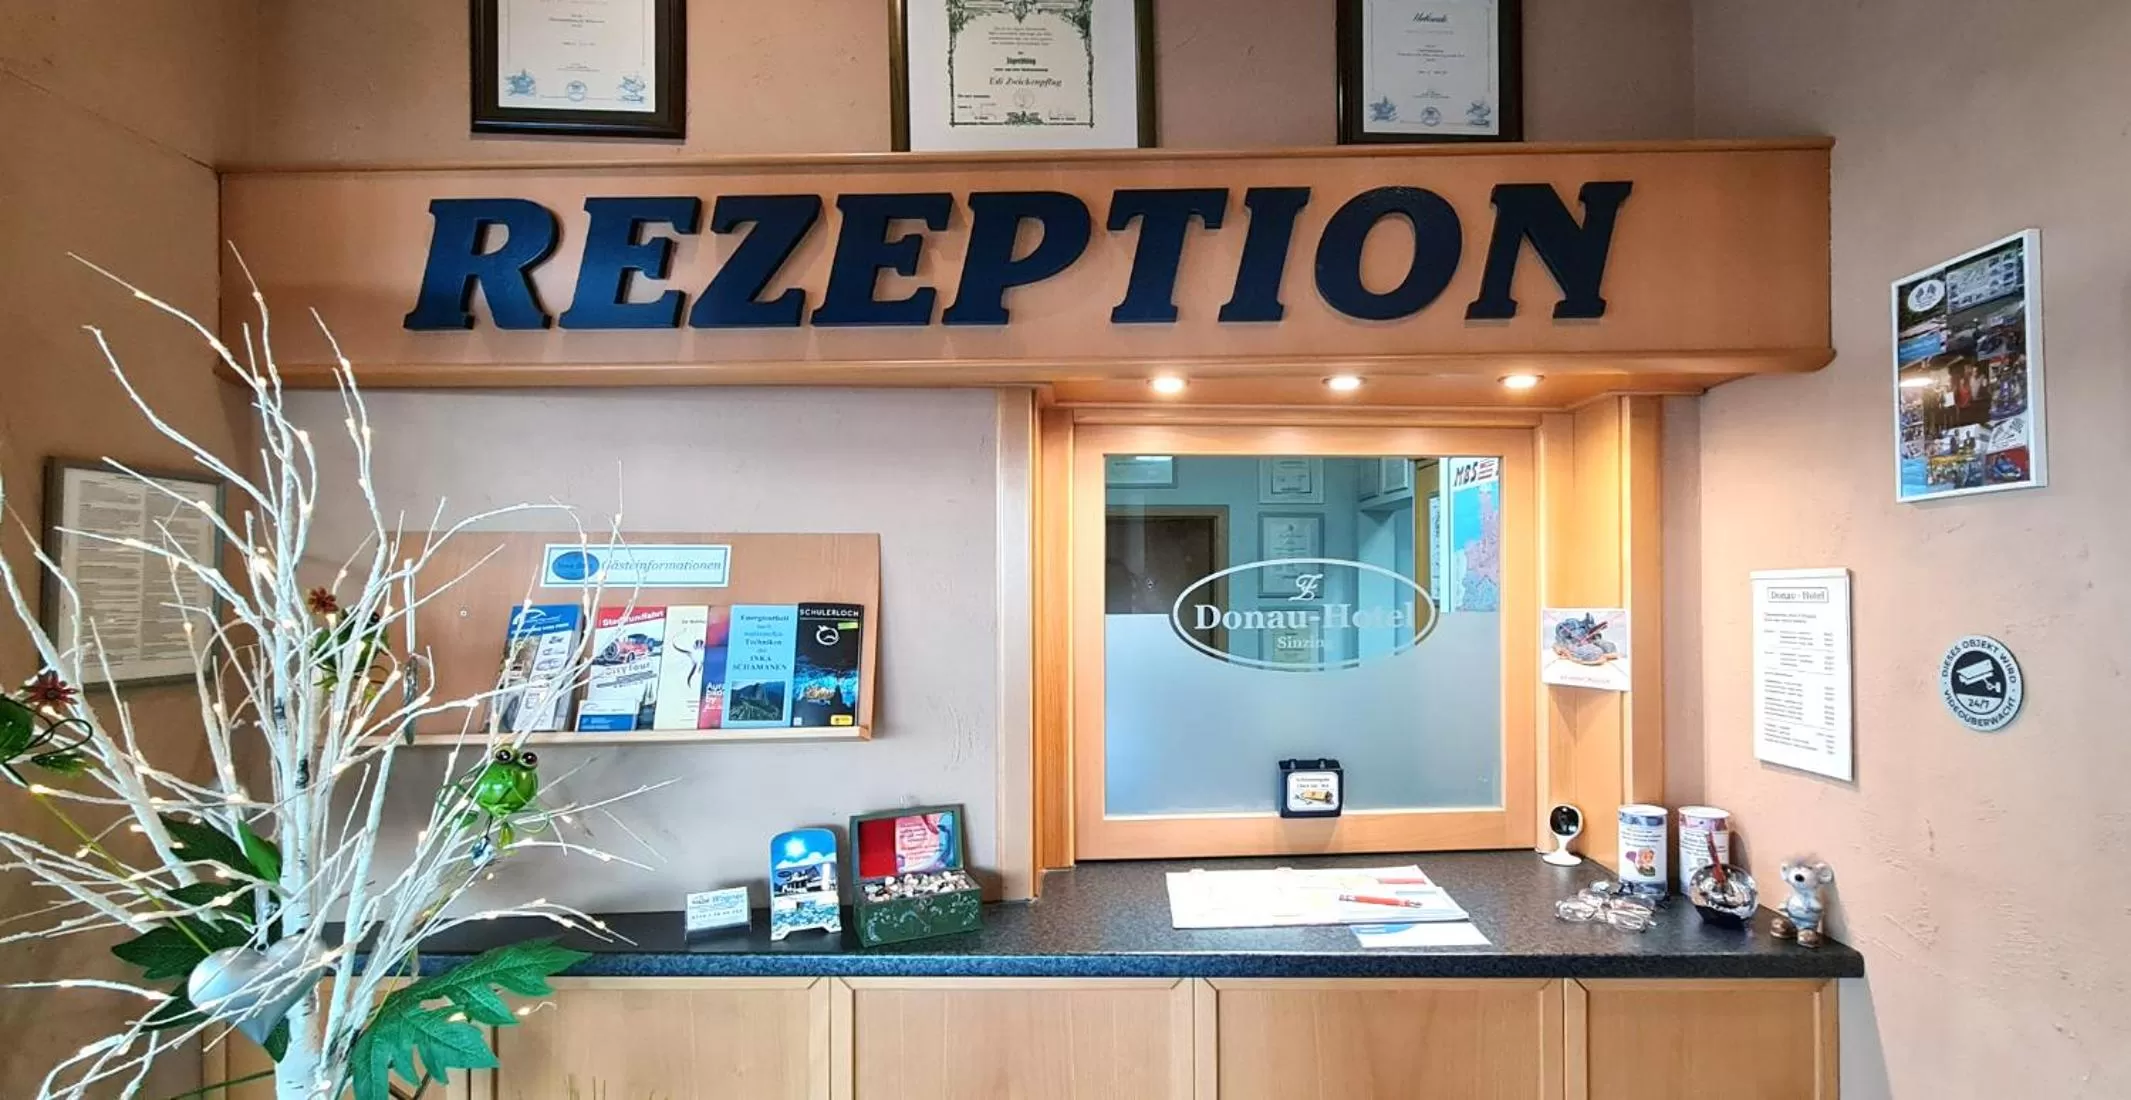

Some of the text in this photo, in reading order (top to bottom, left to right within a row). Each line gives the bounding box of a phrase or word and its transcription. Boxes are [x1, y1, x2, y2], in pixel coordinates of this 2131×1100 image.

[403, 181, 1634, 330] REZEPTION
[799, 608, 859, 617] SCHULERLOCH
[1194, 602, 1414, 630] Donau-Hotel
[1276, 636, 1334, 650] Sinzin
[1941, 639, 2017, 684] DIESES OBJEKT WIRD
[1967, 697, 1990, 709] 24/7
